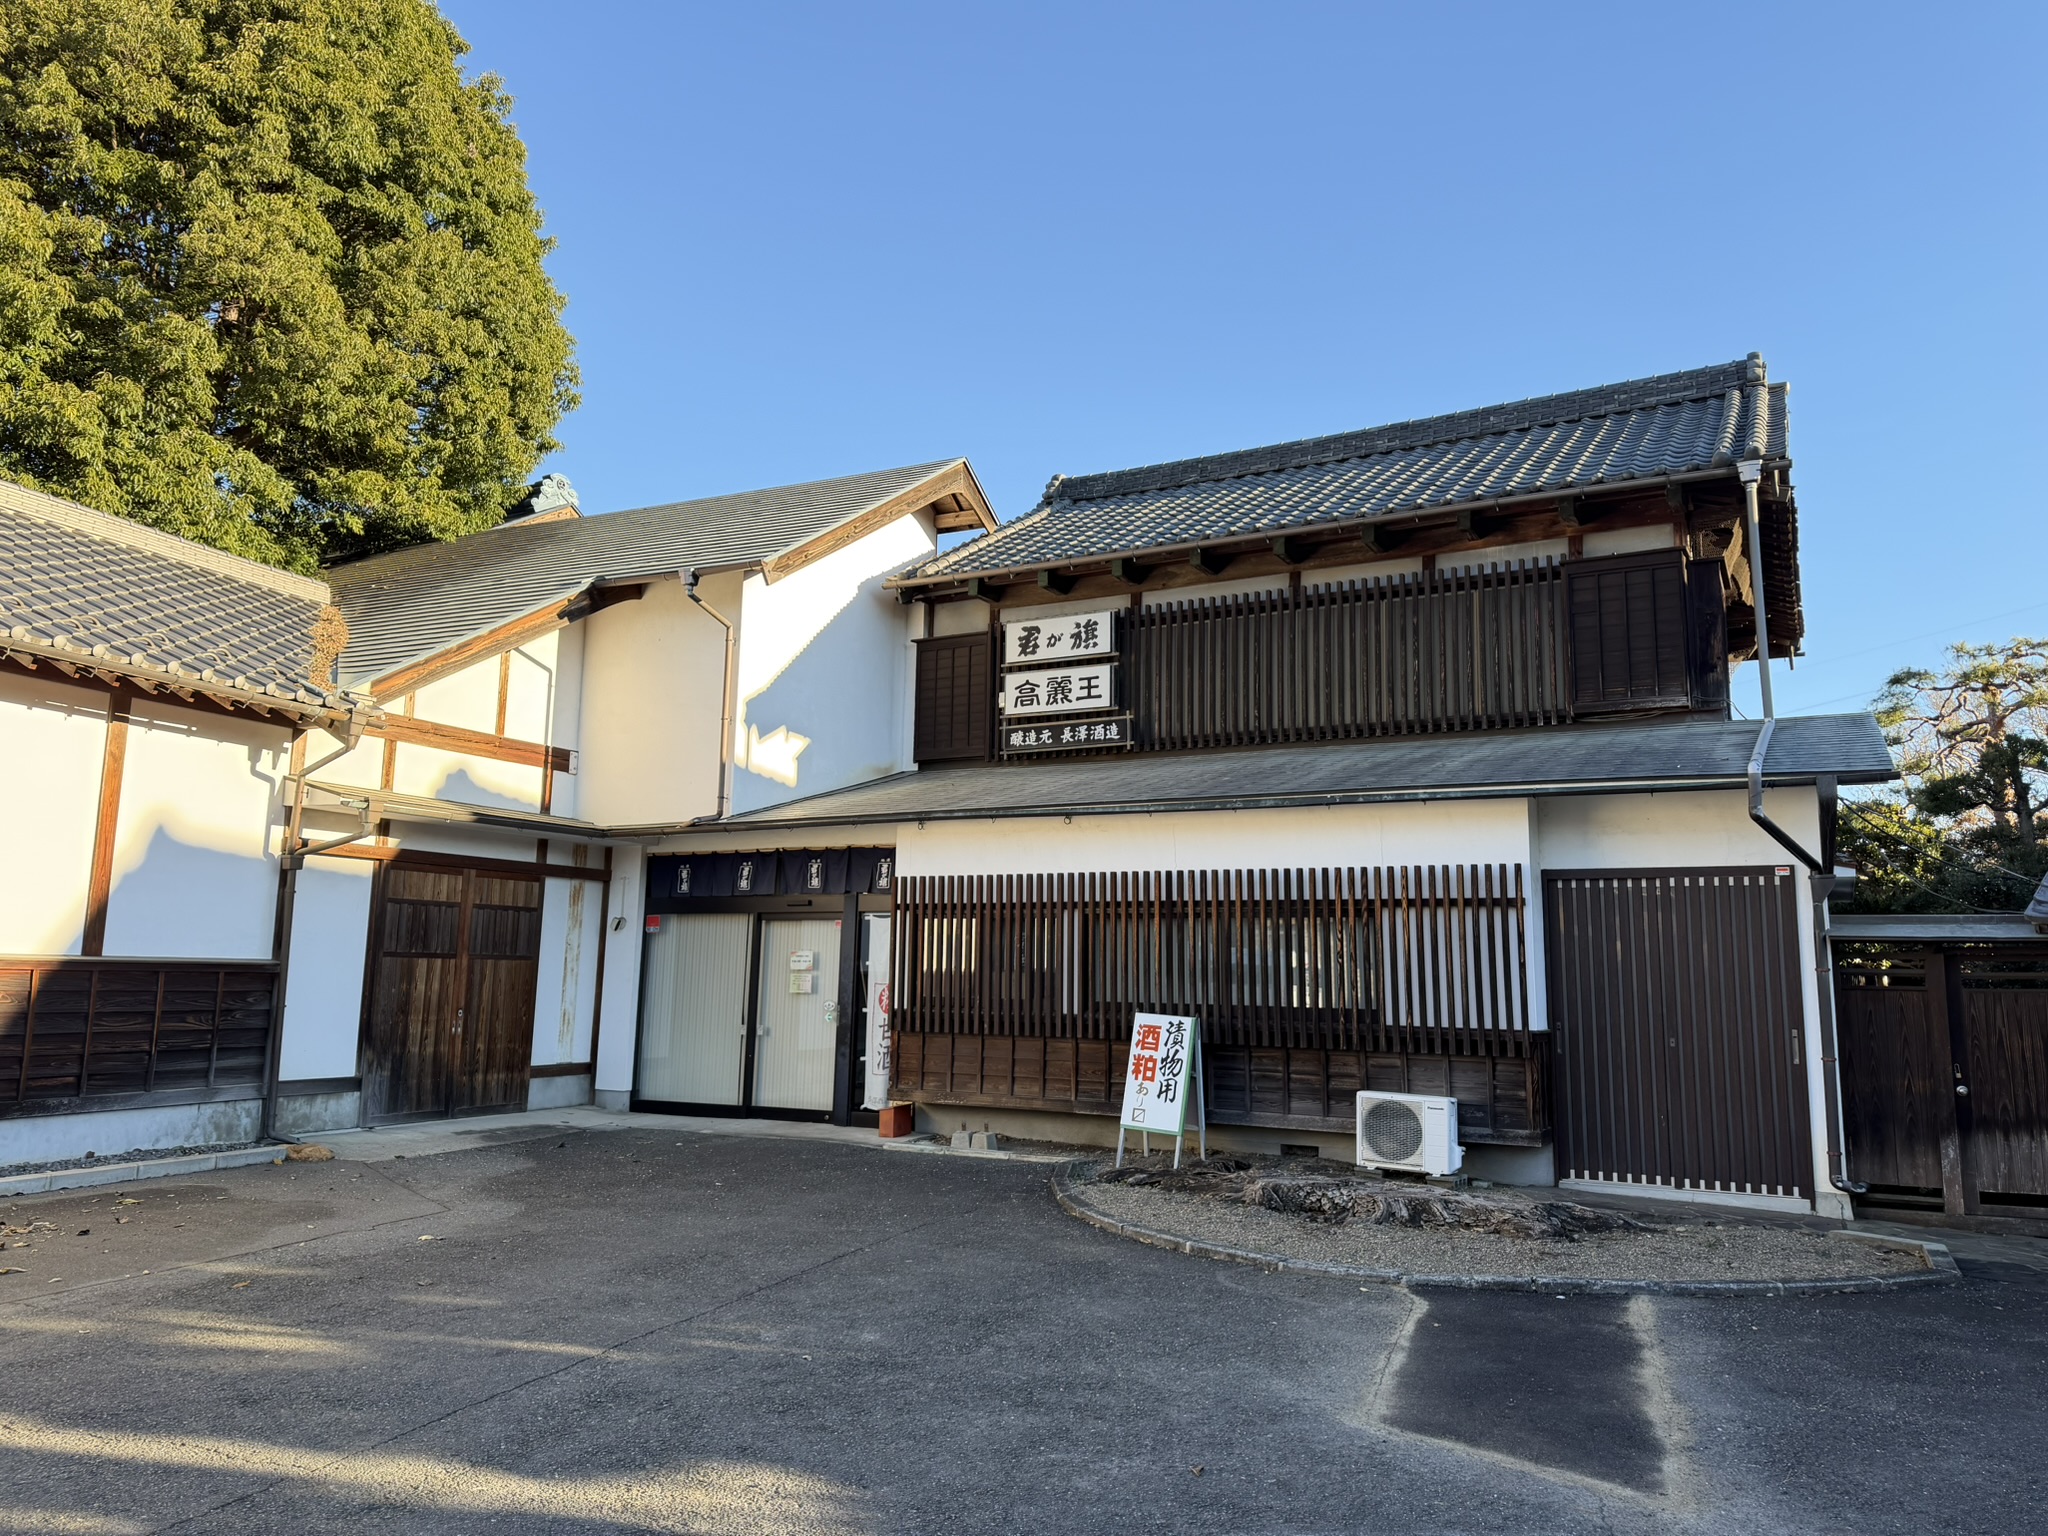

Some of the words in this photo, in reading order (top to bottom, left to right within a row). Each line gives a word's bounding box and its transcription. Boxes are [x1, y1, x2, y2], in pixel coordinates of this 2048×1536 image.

[1017, 618, 1100, 658] 君が旗
[1014, 675, 1103, 709] 高麗王
[1060, 722, 1121, 744] 長澤酒造
[1156, 1019, 1187, 1104] 漬物用
